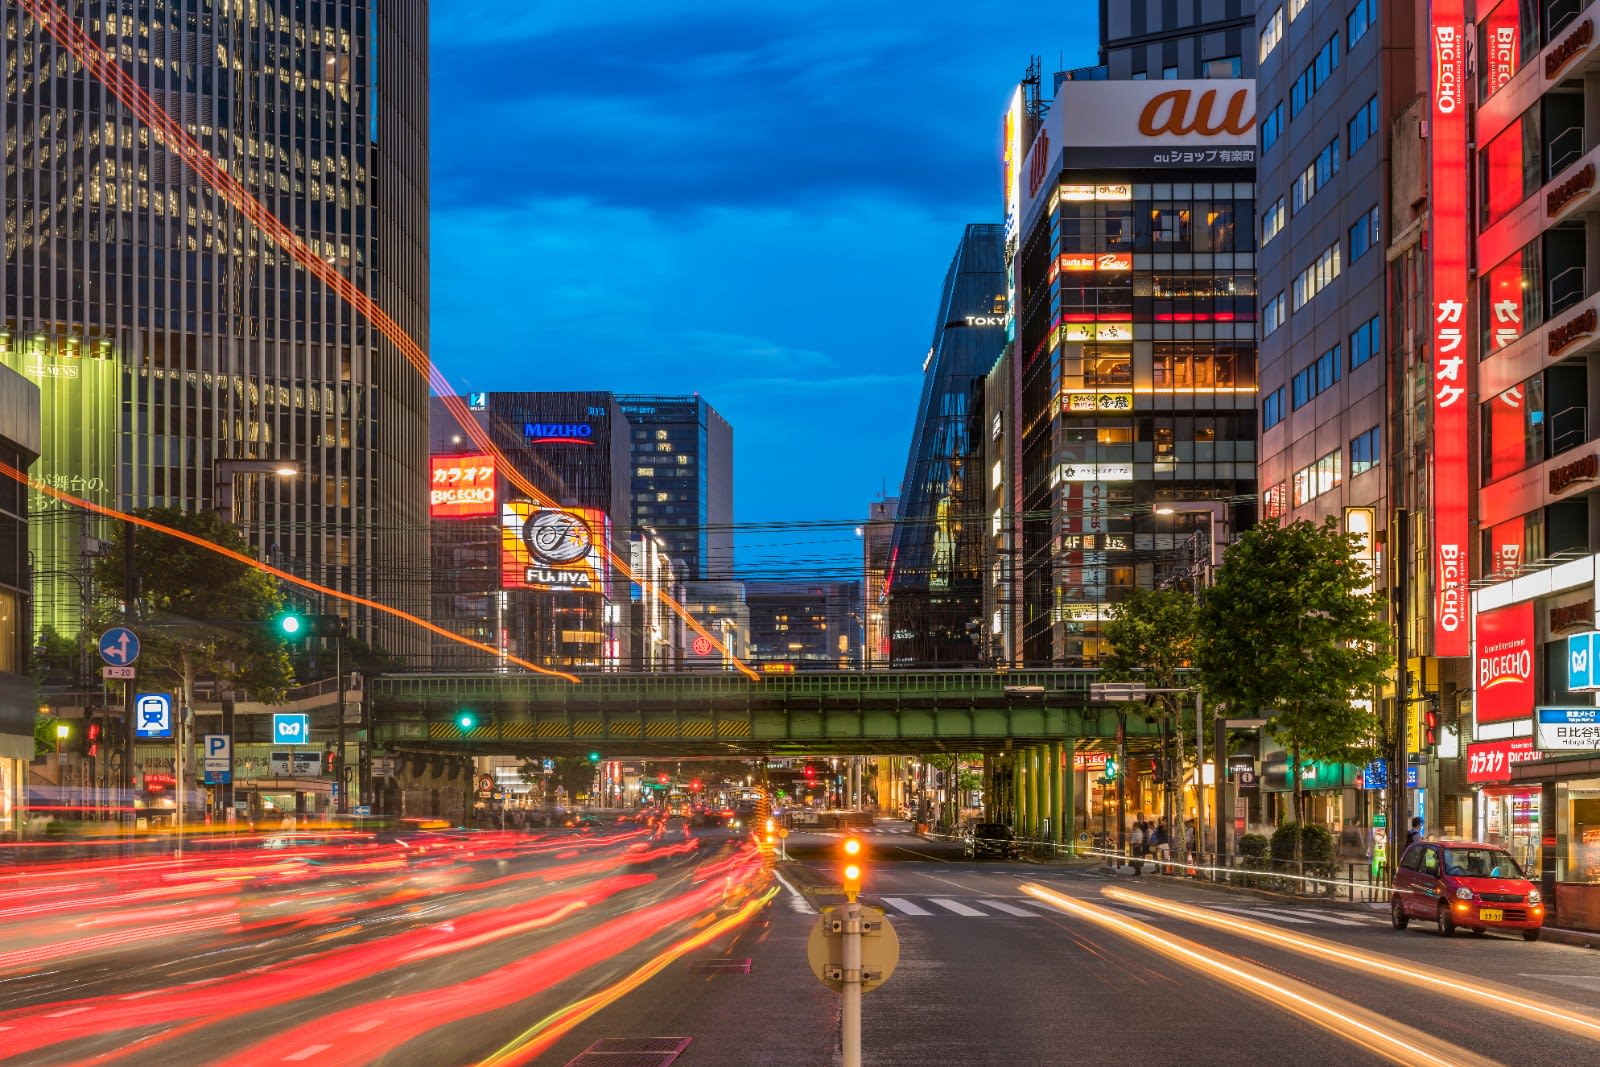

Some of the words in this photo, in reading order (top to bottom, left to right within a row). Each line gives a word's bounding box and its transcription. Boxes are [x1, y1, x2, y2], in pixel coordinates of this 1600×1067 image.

[1437, 26, 1454, 61] BIG
[1438, 63, 1455, 113] ECHO
[1138, 88, 1256, 136] au
[1436, 299, 1464, 408] カラオケ
[524, 422, 592, 438] MIZUHO
[432, 466, 494, 483] カラオケ
[431, 490, 456, 505] BIG
[457, 487, 495, 502] ECHO
[1064, 535, 1080, 548] 4F
[526, 569, 591, 585] FUJIYA
[1440, 544, 1458, 583] BIG
[1442, 584, 1458, 632] ECHO
[1480, 657, 1500, 687] BIG
[1500, 649, 1530, 678] ECHO
[210, 737, 225, 756] P
[1471, 750, 1505, 774] カラオケ
